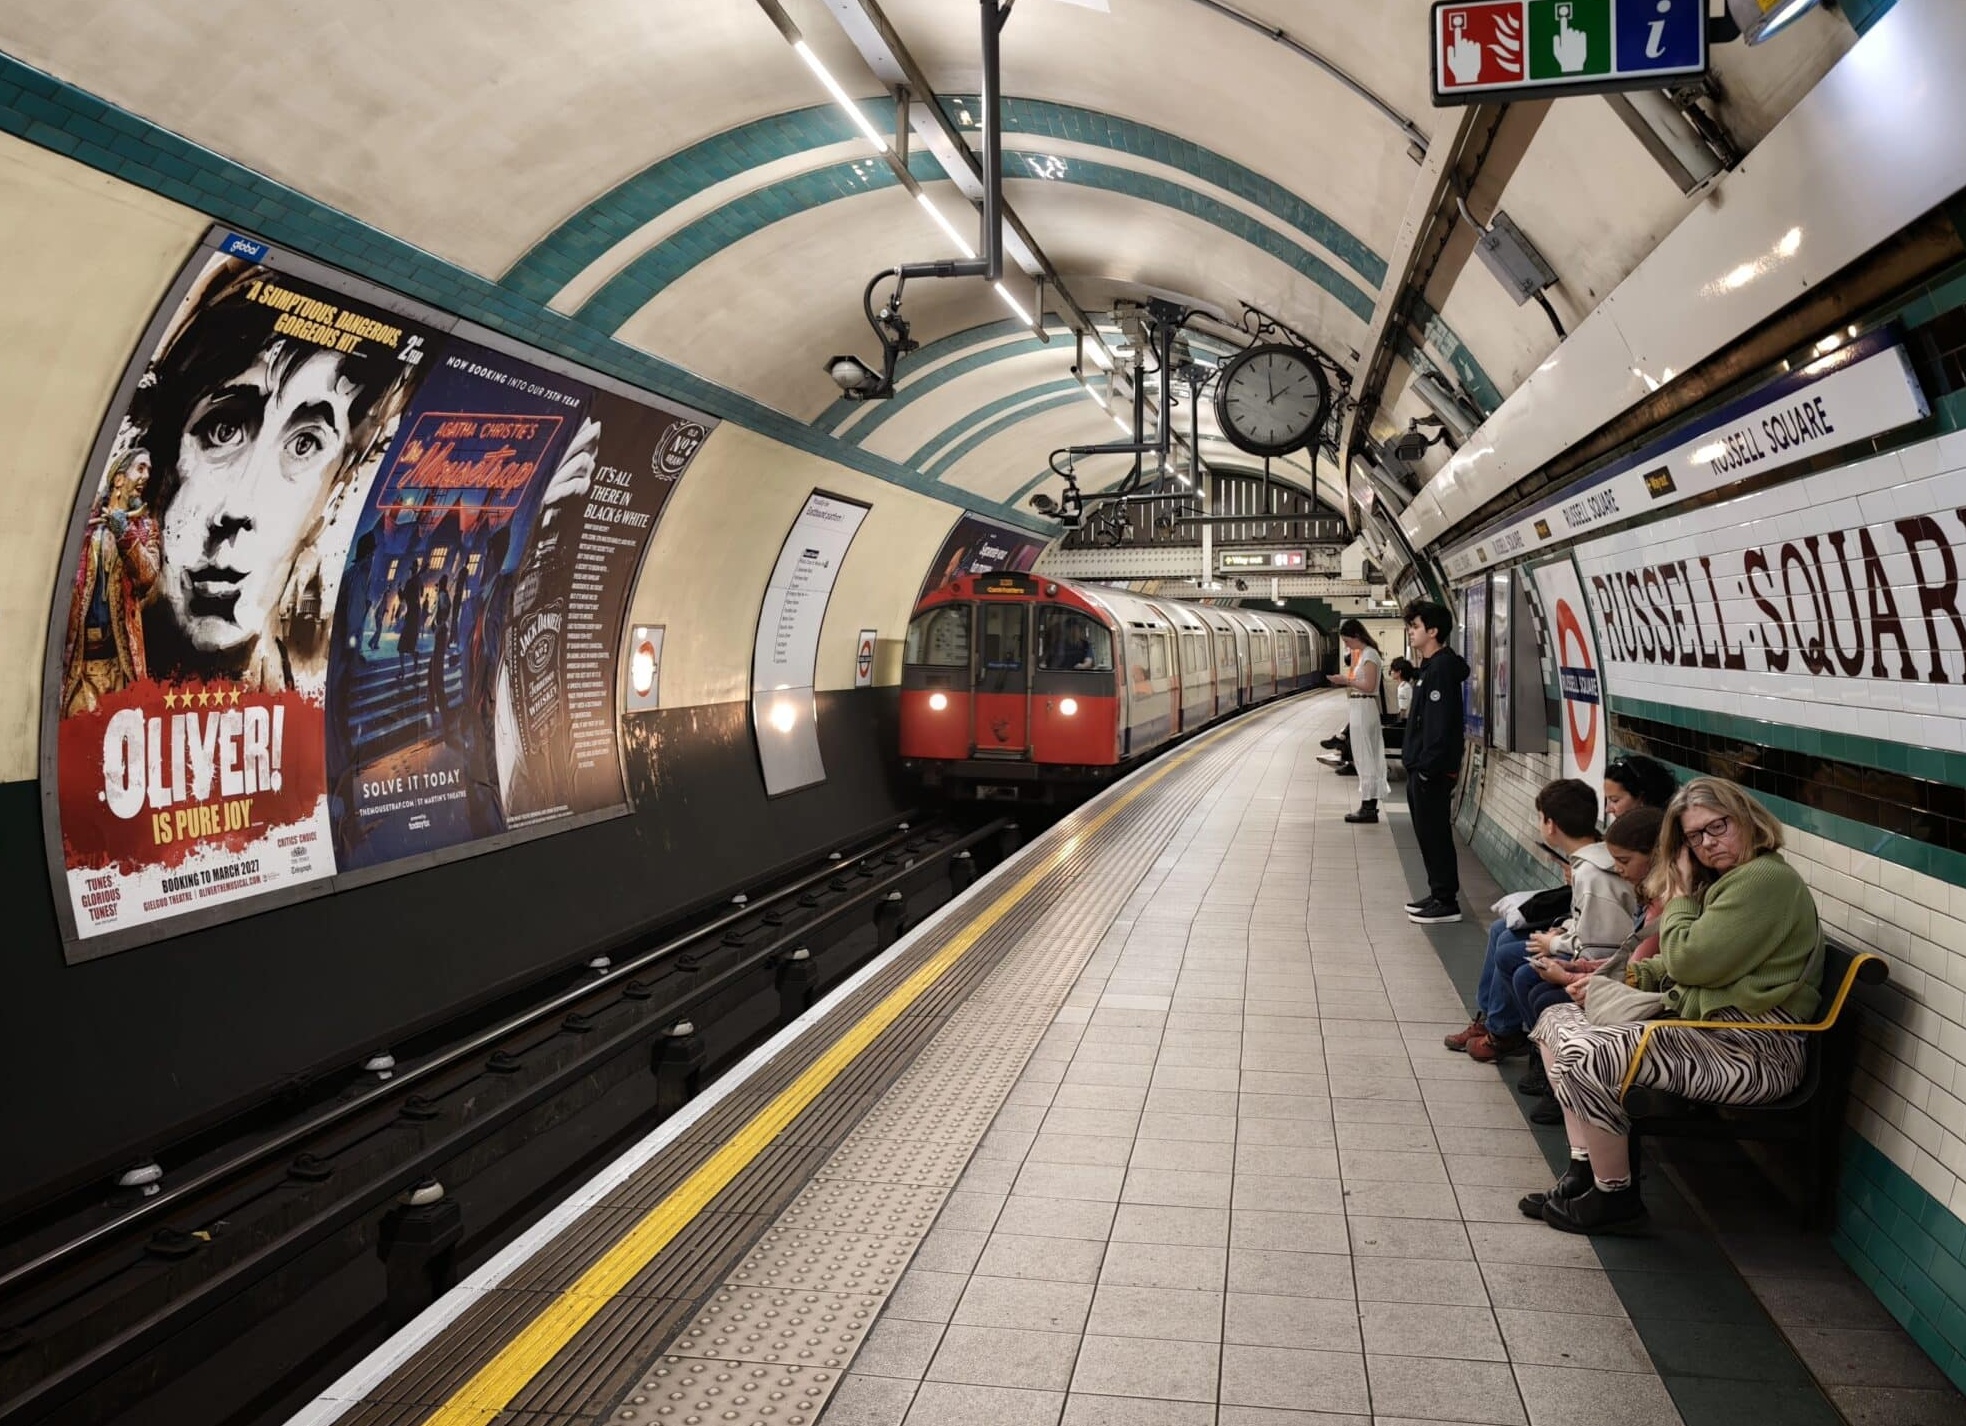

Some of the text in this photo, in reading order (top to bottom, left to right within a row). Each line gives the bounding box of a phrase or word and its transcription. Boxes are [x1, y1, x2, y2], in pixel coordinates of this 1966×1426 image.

[230, 238, 259, 256] global
[258, 284, 338, 326] SUMPTUOUS,
[334, 310, 402, 349] DANGEROUS,
[274, 313, 341, 348] GORGEOUS
[446, 356, 470, 370] NOW
[468, 363, 508, 384] BOOKING
[507, 377, 528, 391] INTO
[527, 384, 545, 397] OUR
[561, 394, 580, 408] YEAR
[434, 421, 539, 440] AGATHA CHRISTIE'S
[1761, 396, 1834, 454] SQUARE
[397, 442, 534, 499] Mousetrap
[595, 466, 633, 487] IT'S ALL
[590, 485, 633, 506] THERE IN
[1562, 489, 1619, 529] RUSSELL SQUARE
[583, 503, 617, 523] BLACK
[613, 509, 623, 523] &
[621, 510, 650, 528] WHITE
[1744, 507, 1966, 685] SQUAR
[520, 621, 537, 657] JACK
[1579, 676, 1598, 697] SQUARE
[100, 704, 285, 820] OLIVER!
[362, 769, 461, 798] SOLVE IT TODAY
[152, 811, 173, 845] IS
[175, 805, 221, 841] PURE
[161, 859, 260, 894] BOOKING TO MARCH 2027
[81, 888, 120, 908] GLORIOUS
[168, 892, 192, 905] THEATRE
